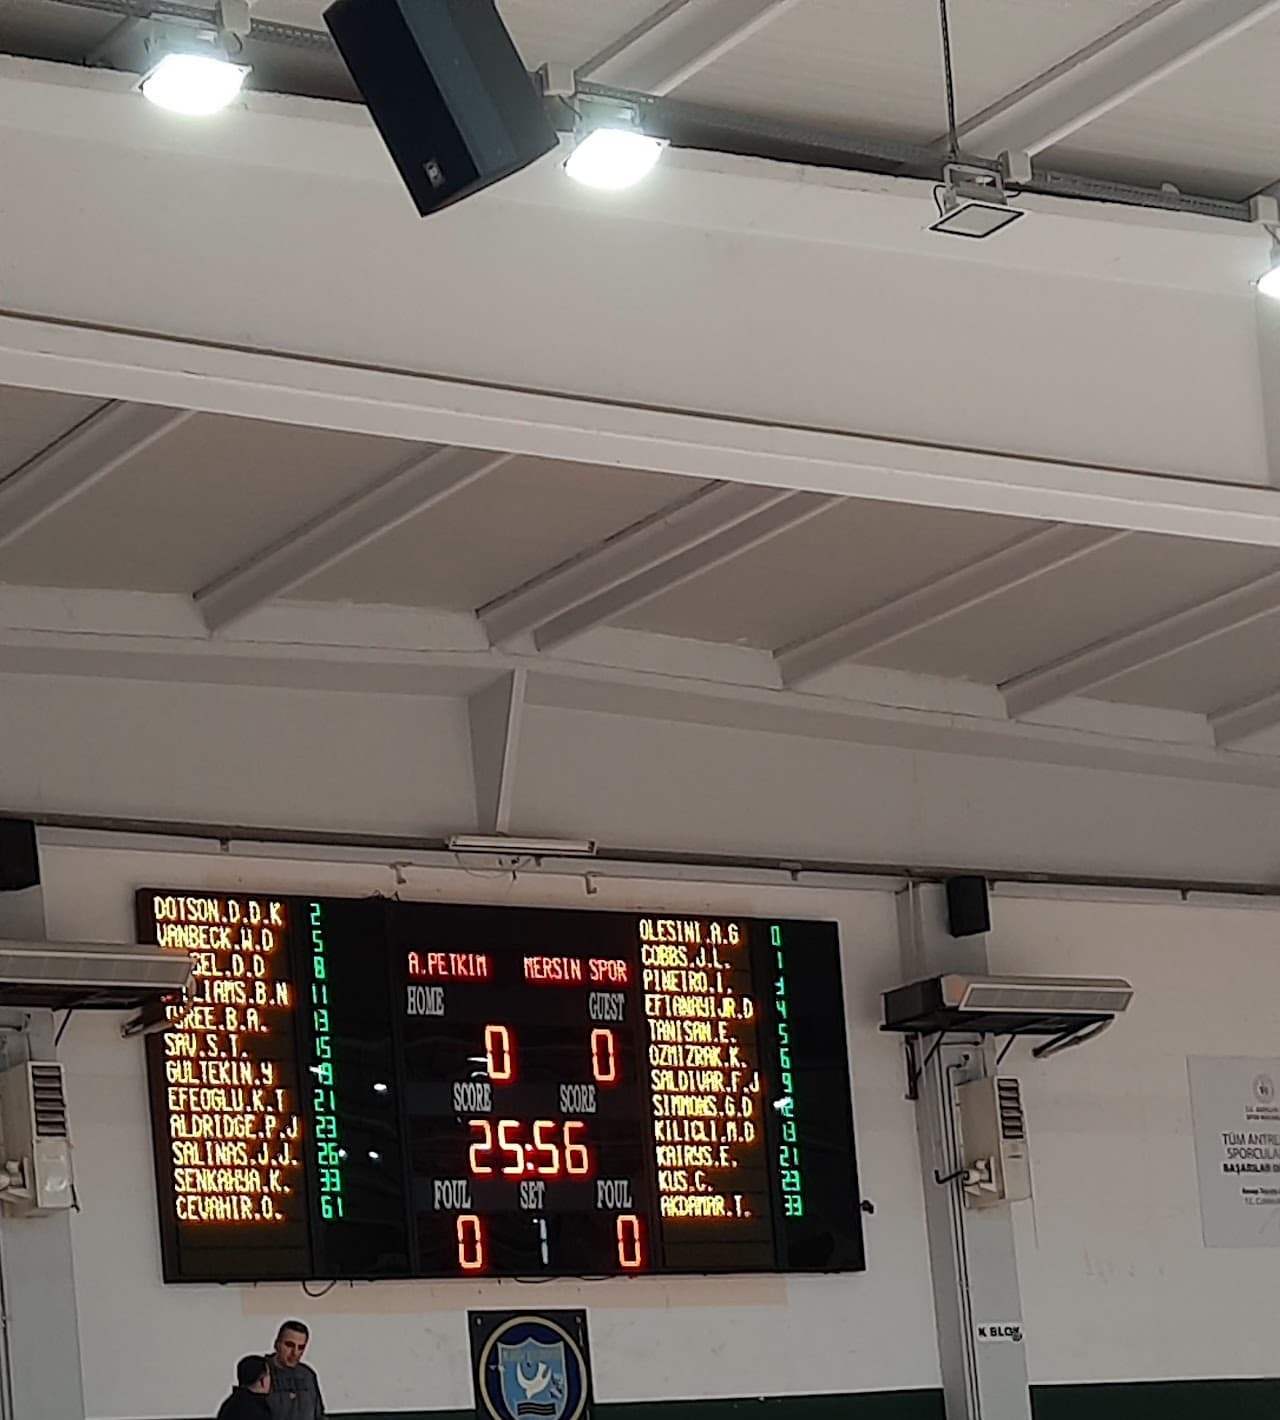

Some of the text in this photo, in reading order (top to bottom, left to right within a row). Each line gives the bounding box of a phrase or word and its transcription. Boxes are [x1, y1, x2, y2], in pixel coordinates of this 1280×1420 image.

[153, 896, 321, 926] DOTSON.D.D.K 2
[312, 930, 323, 952] 5
[770, 925, 781, 946] 0
[313, 956, 326, 979] 8
[408, 951, 488, 977] A.PETKIM
[523, 956, 628, 982] MERSIN SPOR
[777, 951, 784, 969] 1
[312, 983, 328, 1005] 11
[407, 985, 445, 1016] HOME
[588, 992, 625, 1021] GUEST
[314, 1008, 329, 1032] 13
[775, 999, 787, 1019] 4
[778, 1023, 790, 1044] 5
[316, 1035, 332, 1059] 15
[485, 1025, 511, 1080] 0
[591, 1028, 616, 1081] 0
[780, 1048, 791, 1069] 6
[781, 1072, 793, 1093] 9
[167, 1087, 336, 1112] EFEOGLU.K.T 21
[453, 1082, 492, 1112] SCORE
[559, 1084, 597, 1113] SCORE
[169, 1114, 337, 1139] ALDRIDGE.P.J 23
[317, 1142, 339, 1165] 26
[468, 1119, 589, 1174] 25:56
[780, 1145, 799, 1167] 21
[320, 1168, 341, 1192] 33
[321, 1195, 344, 1219] 61
[433, 1180, 472, 1210] FOUL
[520, 1181, 546, 1210] SET
[597, 1180, 633, 1209] FOUL
[784, 1195, 802, 1216] 33
[457, 1214, 483, 1269] 0
[617, 1214, 641, 1267] 0
